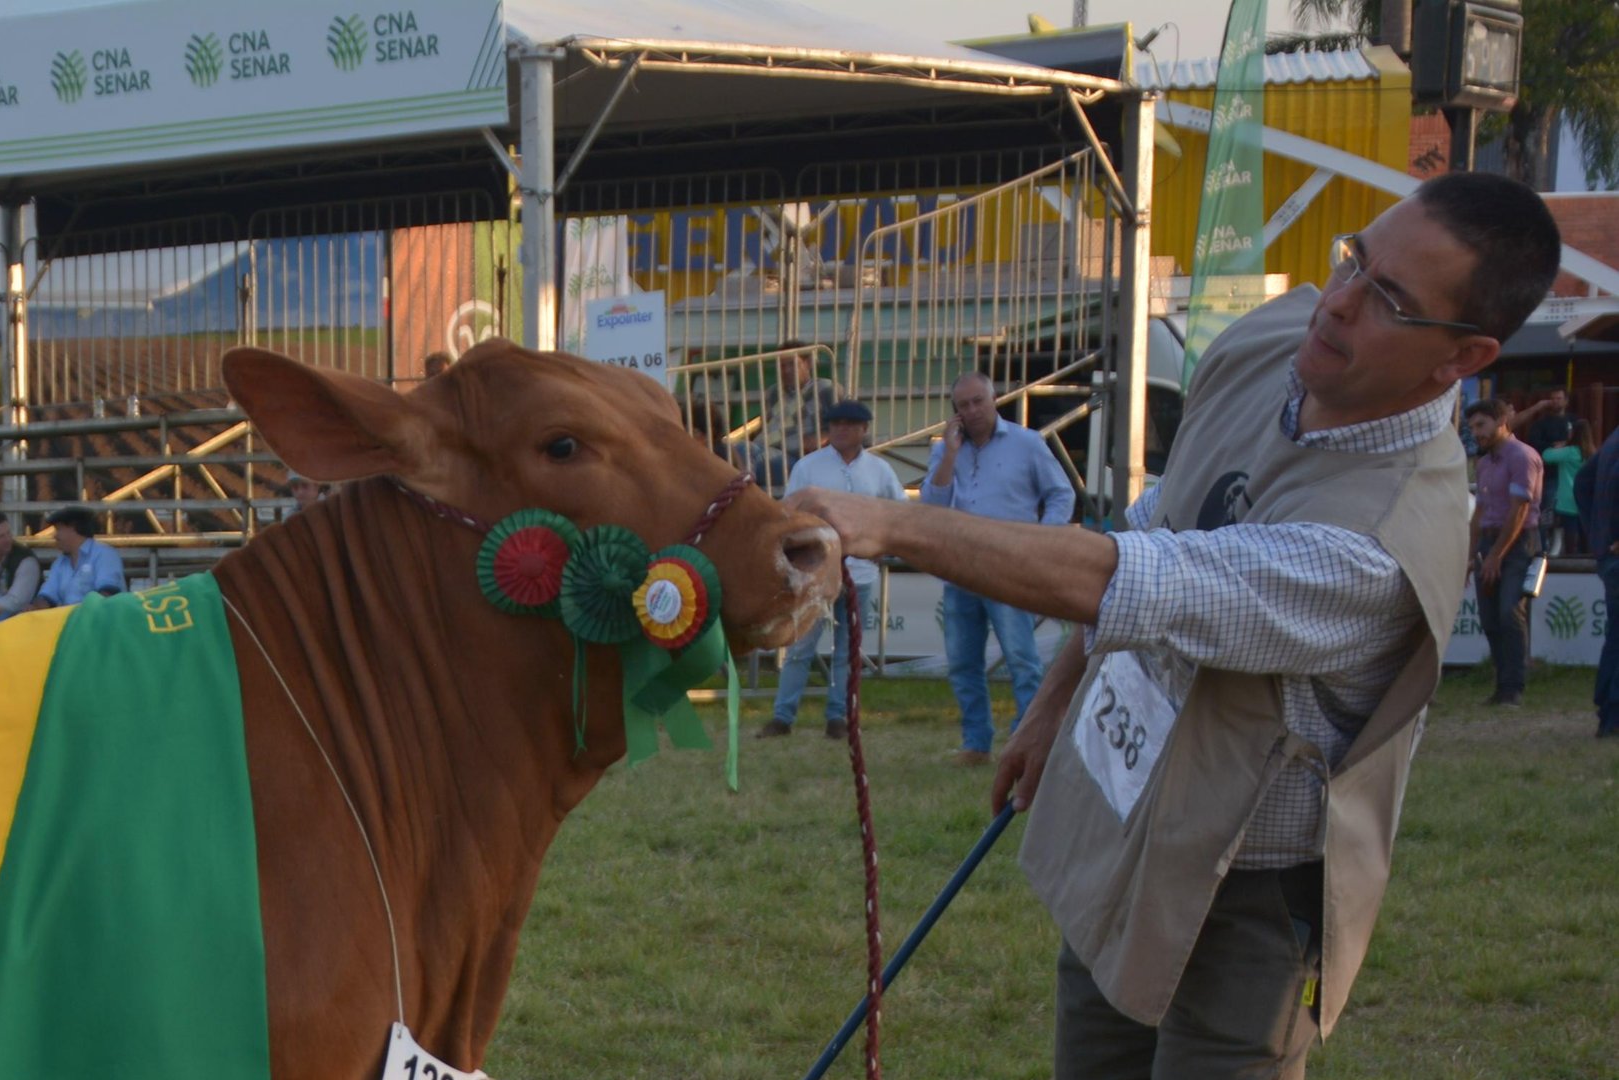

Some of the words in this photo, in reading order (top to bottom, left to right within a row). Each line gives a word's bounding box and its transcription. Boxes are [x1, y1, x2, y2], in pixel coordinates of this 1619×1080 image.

[374, 10, 418, 36] CNA
[228, 30, 270, 54] CNA
[375, 34, 439, 63] SENAR
[92, 48, 132, 71] CNA
[230, 53, 291, 80] SENAR
[94, 70, 151, 96] SENAR
[1209, 236, 1253, 255] ENAR
[597, 311, 653, 329] Expointer
[643, 352, 663, 368] 06
